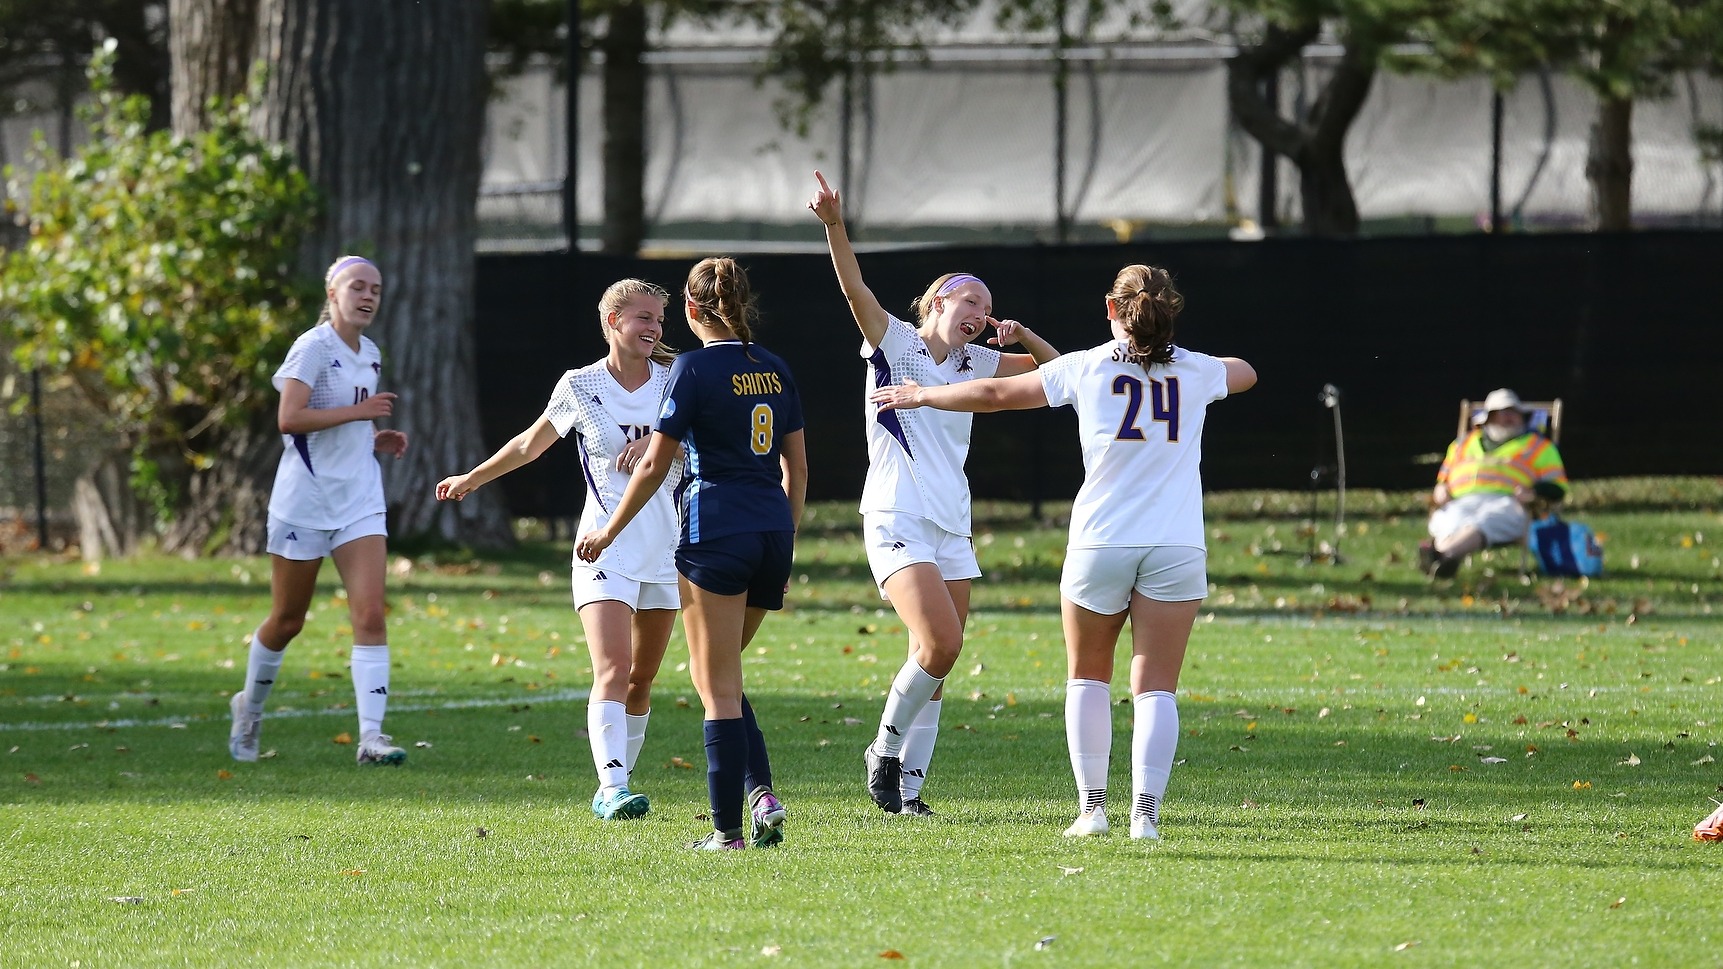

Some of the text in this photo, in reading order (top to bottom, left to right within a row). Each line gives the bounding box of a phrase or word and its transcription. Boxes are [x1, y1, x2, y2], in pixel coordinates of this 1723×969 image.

[732, 372, 782, 396] SAINTS
[1111, 374, 1180, 443] 24
[750, 403, 774, 456] 8
